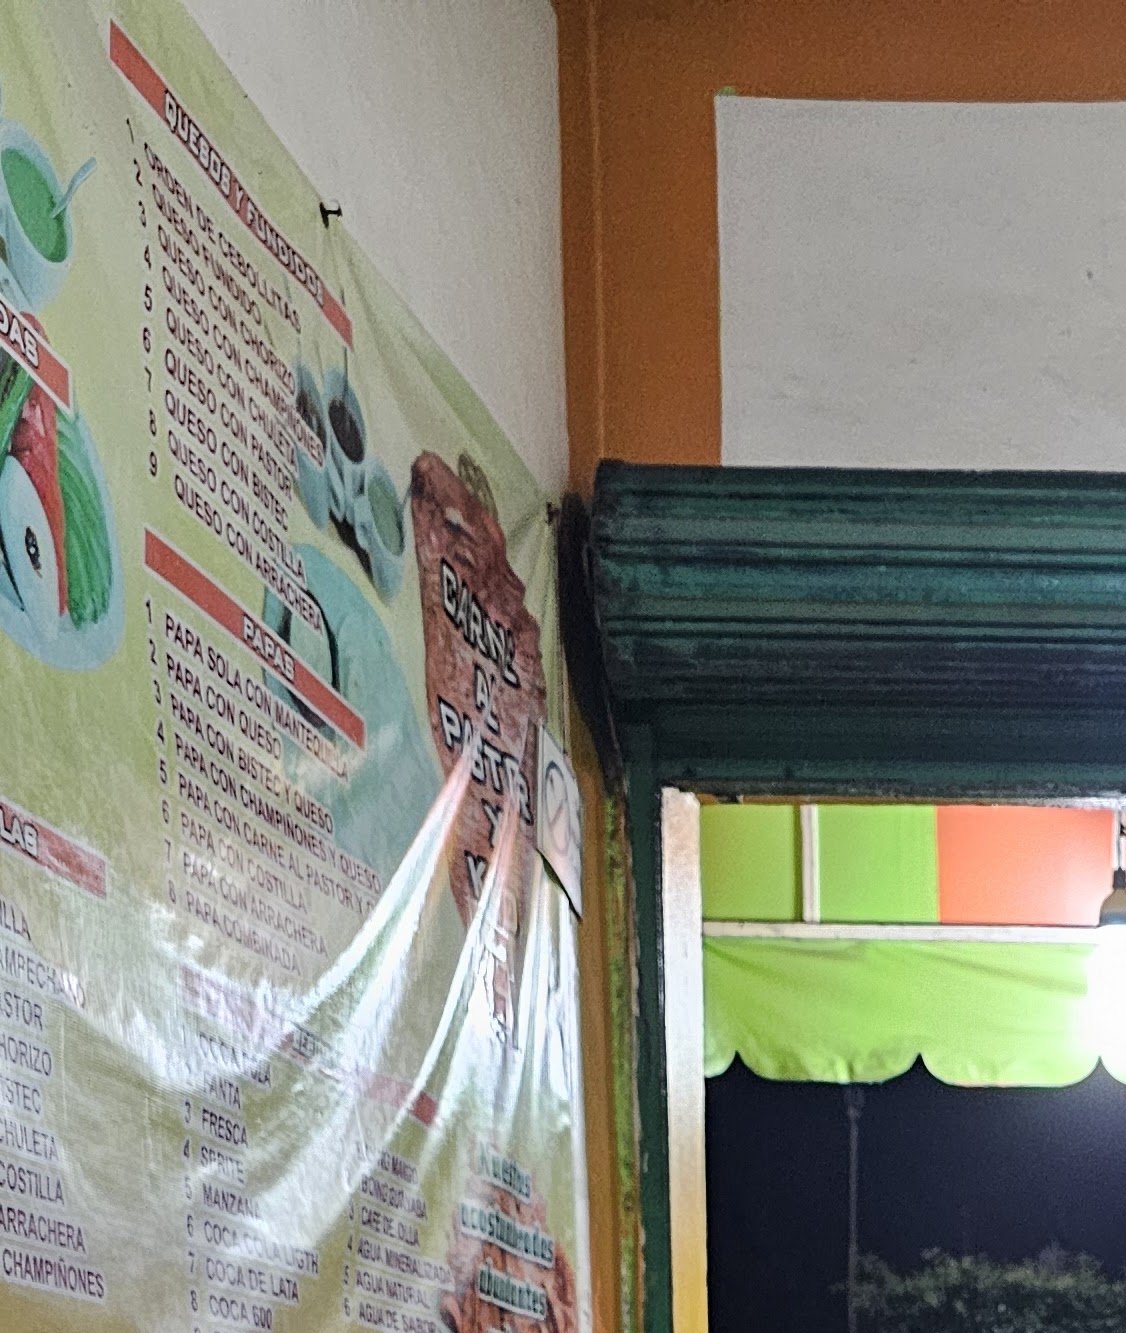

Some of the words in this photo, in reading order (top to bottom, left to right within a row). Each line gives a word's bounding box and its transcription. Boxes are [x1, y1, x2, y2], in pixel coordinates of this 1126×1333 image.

[165, 88, 232, 198] QUESOS
[235, 181, 244, 213] Y
[134, 158, 143, 187] 2
[152, 184, 199, 256] QUESO
[203, 245, 262, 325] FUNDIDO
[144, 142, 193, 217] ORDEN
[197, 204, 216, 245] DE
[219, 232, 301, 334] CEBOLLITAS
[138, 201, 147, 228] 3
[158, 225, 206, 296] QUESO
[208, 286, 238, 334] CON
[240, 320, 295, 396] CHORIZO
[144, 245, 151, 270] 4
[163, 266, 209, 335] QUESO
[213, 324, 242, 373] CON
[143, 327, 151, 354] 6
[165, 348, 216, 415] QUESO
[221, 402, 248, 448] CON
[251, 433, 292, 501] PASTOR
[144, 284, 153, 312] 5
[166, 307, 214, 375] QUESO
[217, 363, 245, 411] CON
[249, 397, 298, 473] CHULETA
[144, 366, 152, 393] 7
[165, 389, 217, 454] QUESO
[222, 441, 249, 487] CON
[252, 472, 288, 531] BISTEC
[149, 409, 157, 437] 8
[169, 430, 216, 493] QUESO
[221, 481, 250, 525] CON
[253, 511, 306, 584] COSTILLA
[150, 451, 158, 477] 9
[175, 474, 222, 535] QUESO
[226, 523, 253, 566] CON
[256, 551, 323, 636] ARRACHERA
[146, 599, 152, 624] 1
[165, 613, 204, 663] PAPA
[207, 646, 243, 695] SOLA
[245, 679, 272, 719] CON
[274, 701, 348, 782] MANTEQUILLA
[149, 638, 157, 665] 2
[166, 653, 203, 702] PAPA
[206, 686, 235, 726] CON
[239, 711, 282, 760] QUESO
[242, 613, 296, 684] PAPAS
[153, 680, 161, 704] 3
[170, 693, 205, 742] PAPA
[206, 724, 234, 763] CON
[238, 748, 281, 798] BISTEC
[284, 784, 291, 804] Y
[294, 790, 333, 834] QUESO
[157, 720, 165, 744] 4
[175, 733, 209, 779] PAPA
[210, 762, 237, 799] CON
[240, 784, 326, 863] CHAMPIÑONES
[328, 846, 338, 867] Y
[339, 854, 382, 894] QUESO
[160, 759, 167, 784] 5
[178, 772, 212, 817] PAPA
[214, 800, 241, 838] CON
[243, 822, 286, 868] CARNE
[289, 853, 304, 881] AL
[306, 864, 353, 908] PASTOR
[354, 894, 363, 916] Y
[162, 800, 170, 824] 6
[181, 812, 216, 854] PAPA
[218, 837, 244, 873] CON
[248, 858, 308, 914] COSTILLA
[164, 839, 171, 863] 7
[183, 851, 218, 894] PAPA
[220, 876, 248, 913] CON
[251, 894, 328, 959] ARRACHERA
[168, 880, 176, 904] 8
[186, 891, 225, 937] PAPA
[223, 914, 300, 976] COMBINADA
[0, 990, 42, 1031] STOR
[185, 1102, 192, 1124] 3
[202, 1109, 248, 1148] FRESCA
[203, 1071, 241, 1110] FANTA
[183, 1139, 190, 1158] 4
[201, 1146, 244, 1184] SPRITE
[185, 1177, 193, 1200] 5
[0, 1203, 86, 1253] ARRACHERA
[2, 1248, 104, 1299] CHAMPIÑONES
[187, 1214, 194, 1237] 6
[204, 1221, 242, 1250] COCA
[244, 1233, 281, 1262] COLA
[188, 1251, 195, 1274] 7
[206, 1256, 246, 1288] COCA
[248, 1268, 267, 1294] DE
[271, 1274, 299, 1303] LATA
[357, 1237, 382, 1262] AGUA
[385, 1246, 453, 1285] MINERALIZADA
[190, 1289, 198, 1312] 8
[209, 1295, 249, 1325] COCA
[252, 1306, 273, 1330] 600
[344, 1265, 349, 1285] 5
[356, 1270, 384, 1295] AGUA
[386, 1278, 430, 1310] NATURAL
[359, 1302, 384, 1325] AGUA
[386, 1309, 400, 1331] DE
